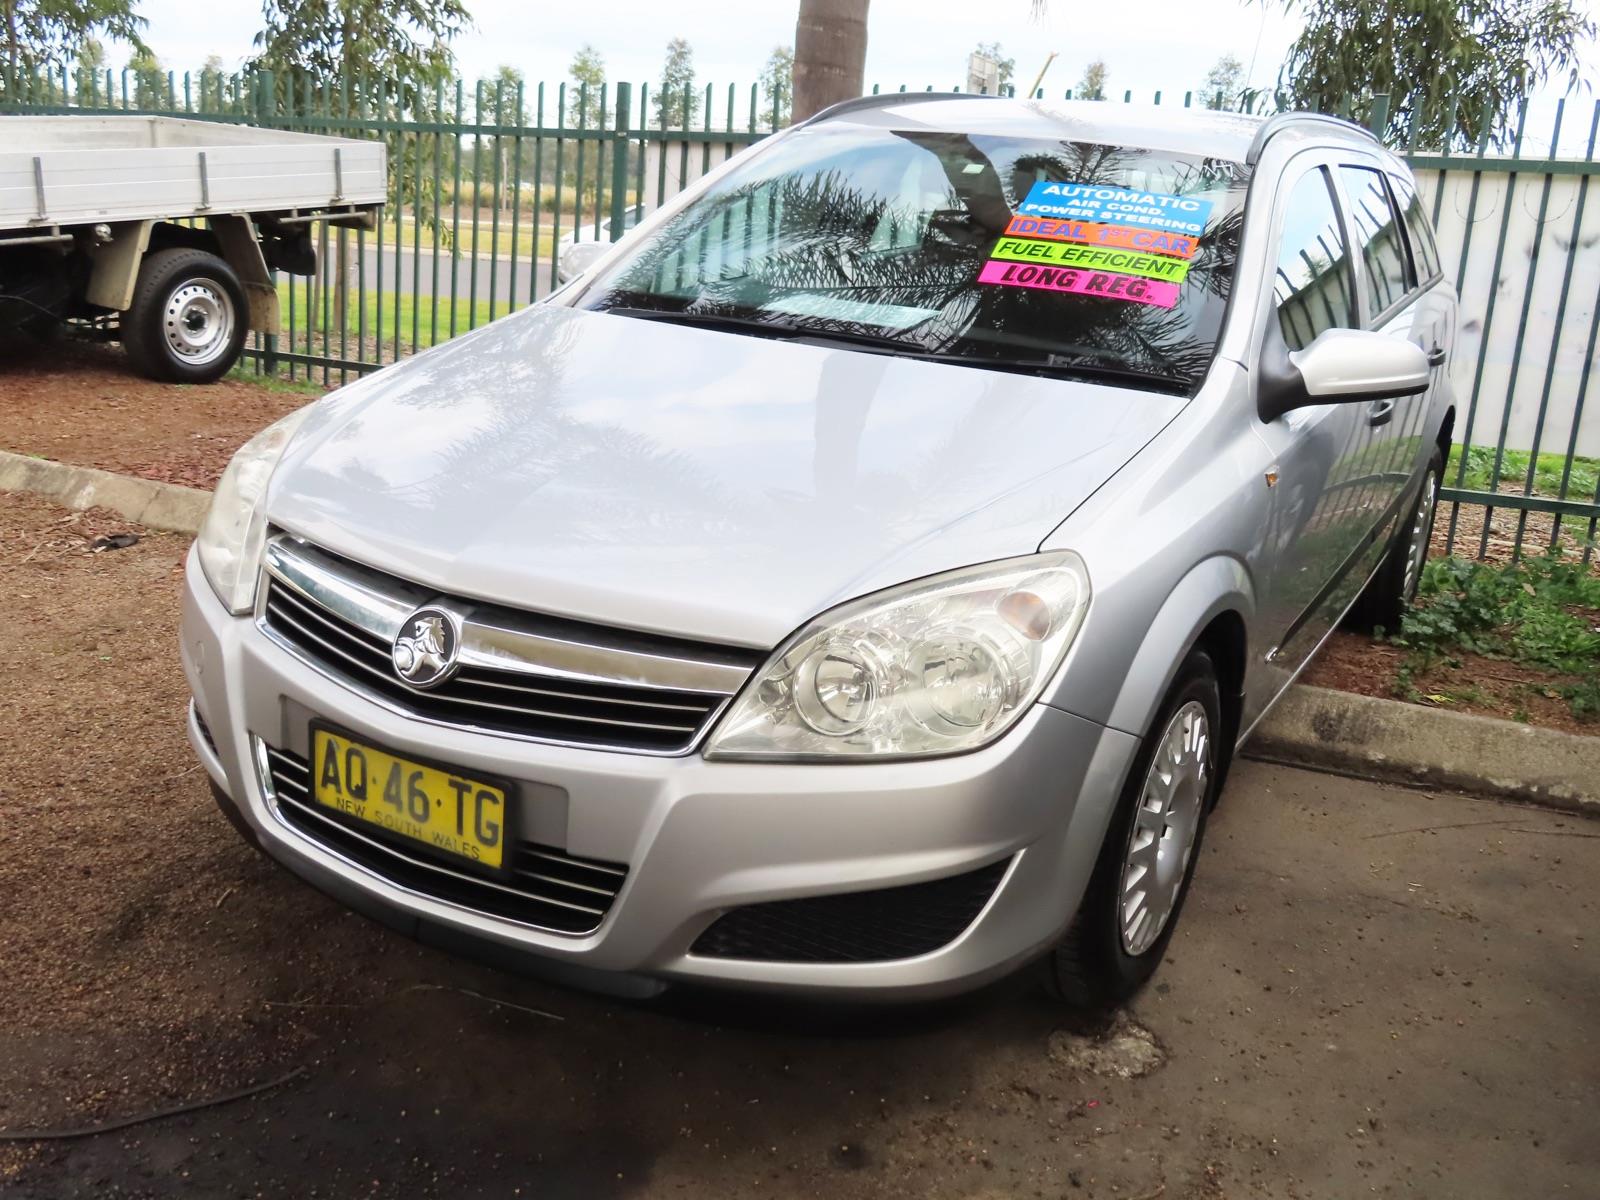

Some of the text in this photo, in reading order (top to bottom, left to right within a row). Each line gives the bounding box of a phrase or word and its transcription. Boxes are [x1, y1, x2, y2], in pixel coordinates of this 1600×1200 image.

[1042, 184, 1201, 212] AUTOMATIC
[1067, 199, 1165, 217] AIR COND.
[1025, 203, 1201, 232] POWER STEERING
[1009, 219, 1086, 240] IDEAL
[1133, 231, 1191, 254] CAR
[998, 241, 1181, 275] FUEL EFFICIENT
[1000, 264, 1154, 301] LONG REG.
[336, 797, 481, 860] NEW SOUTH WALES
